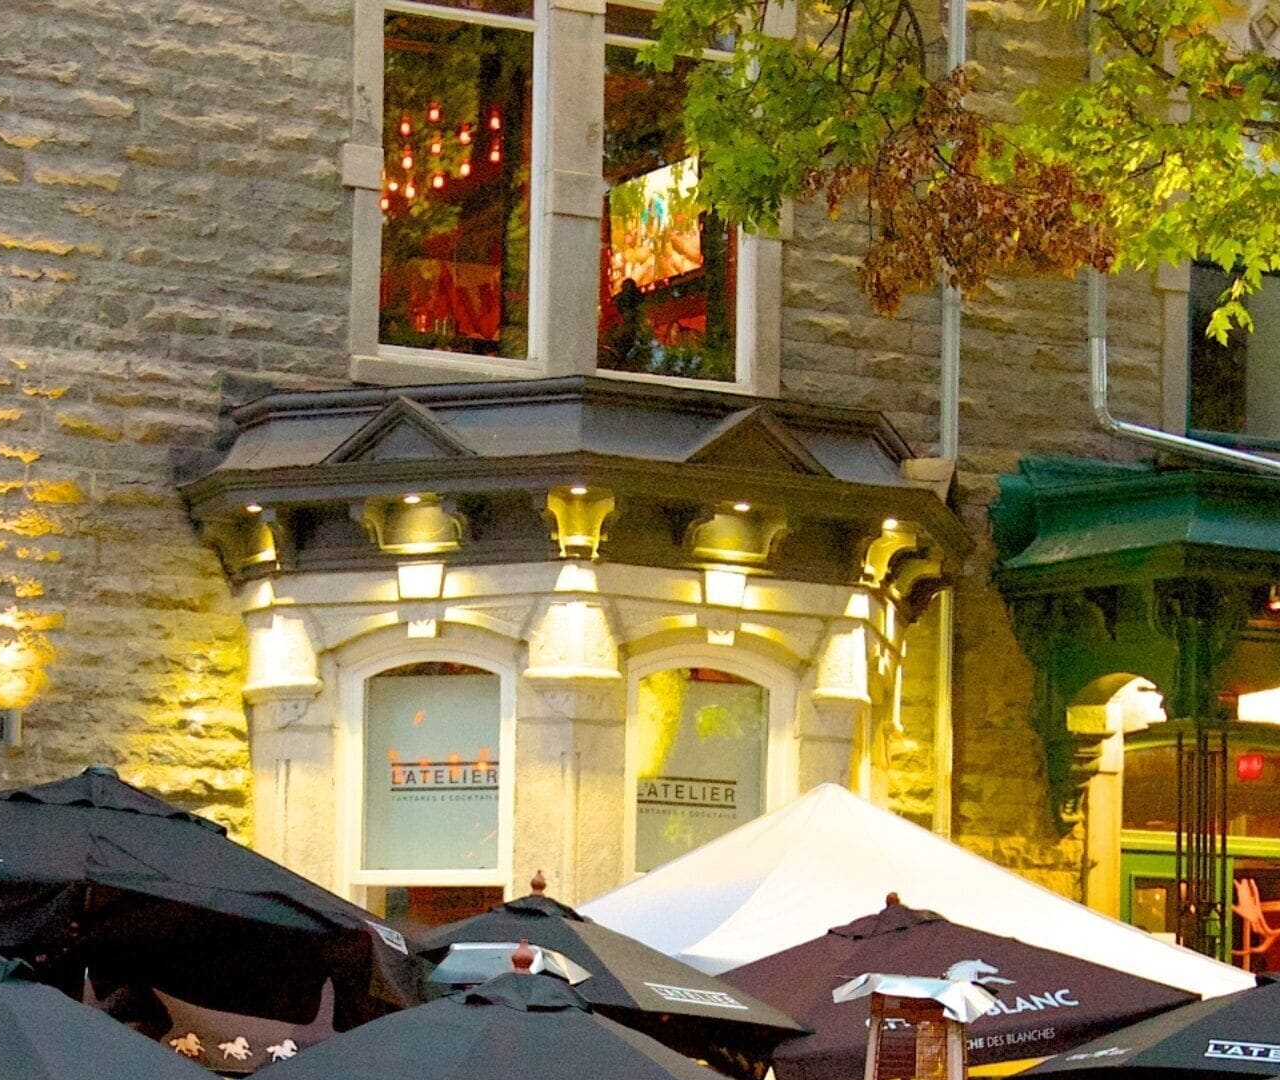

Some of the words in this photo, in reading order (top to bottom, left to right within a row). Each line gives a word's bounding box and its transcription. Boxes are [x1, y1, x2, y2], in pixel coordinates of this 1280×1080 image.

[391, 769, 498, 785] L'ATELIER
[987, 1034, 1005, 1048] DES
[1005, 1027, 1056, 1045] BLANCHES
